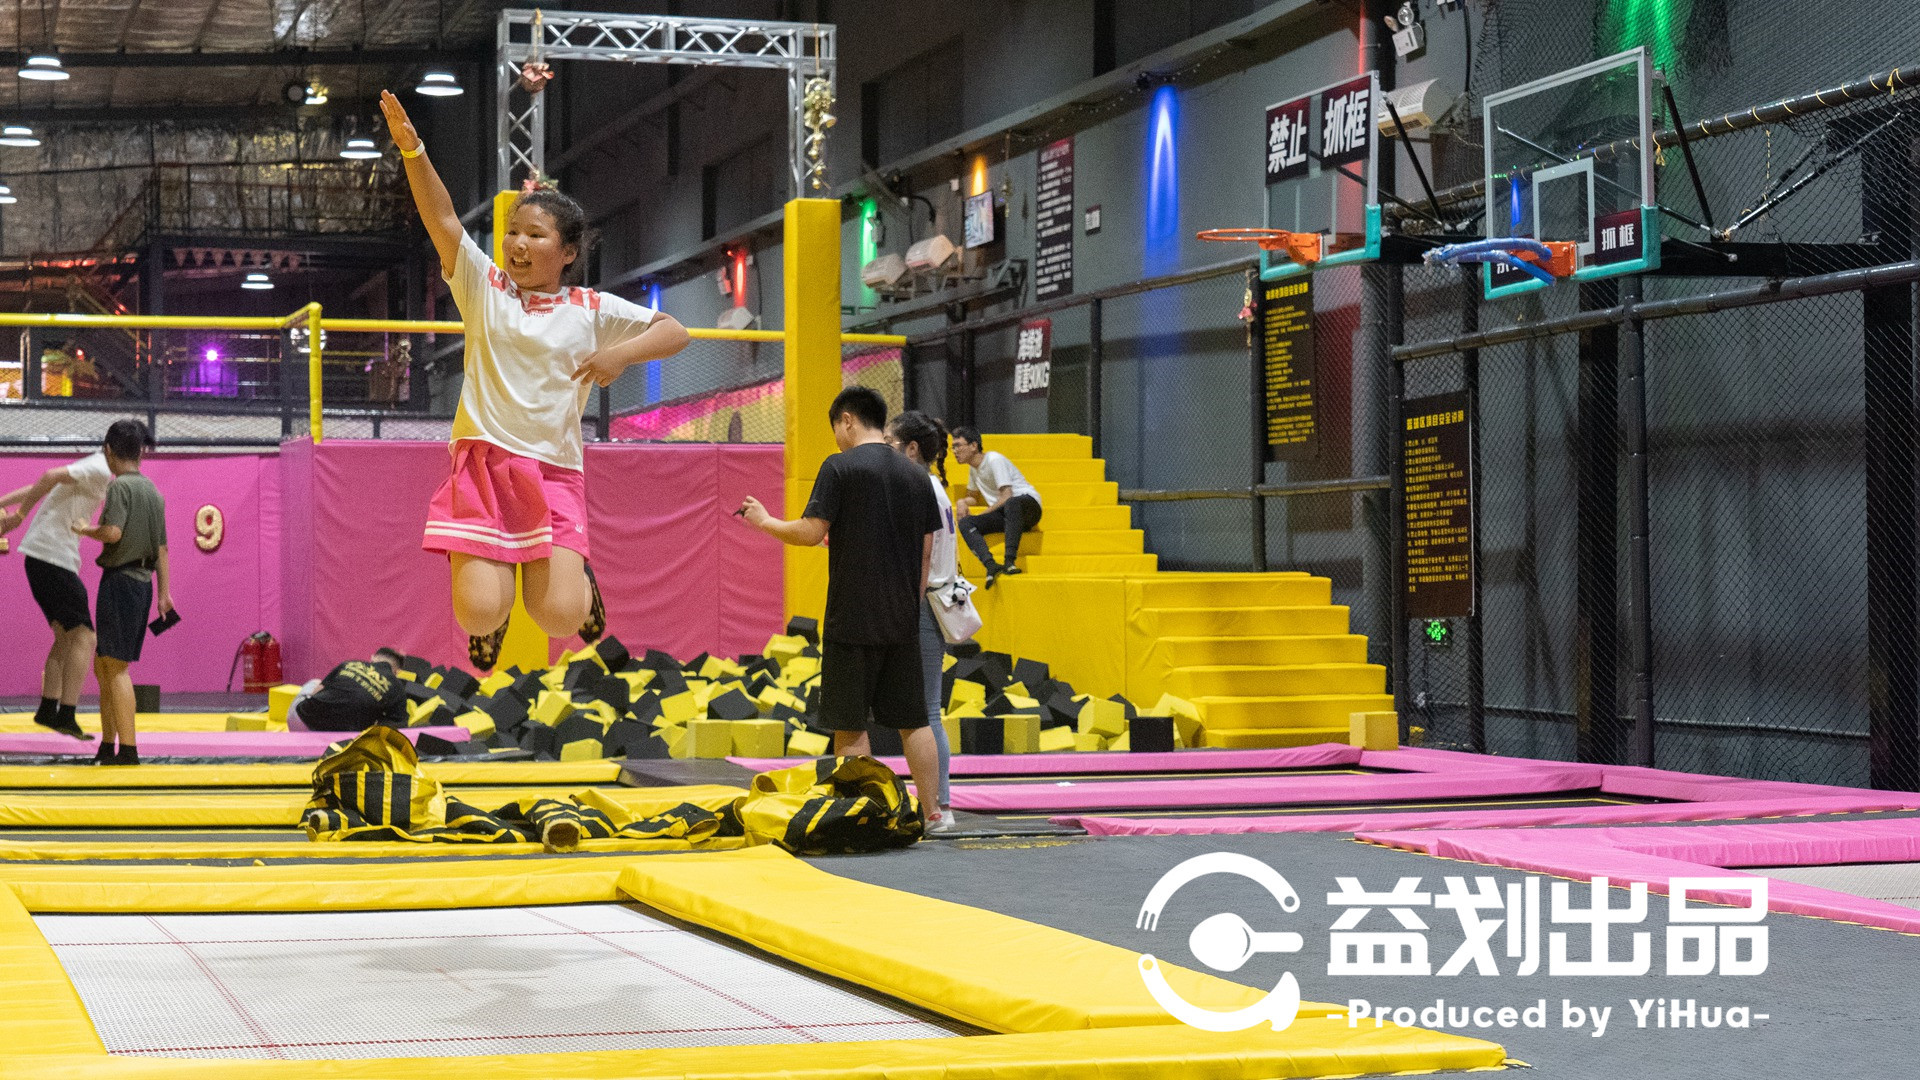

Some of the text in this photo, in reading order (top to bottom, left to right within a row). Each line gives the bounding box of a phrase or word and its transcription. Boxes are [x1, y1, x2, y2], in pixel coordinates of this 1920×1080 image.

[1268, 89, 1369, 173] 禁止 抓框
[1601, 223, 1635, 251] 抓框
[196, 504, 224, 551] 9
